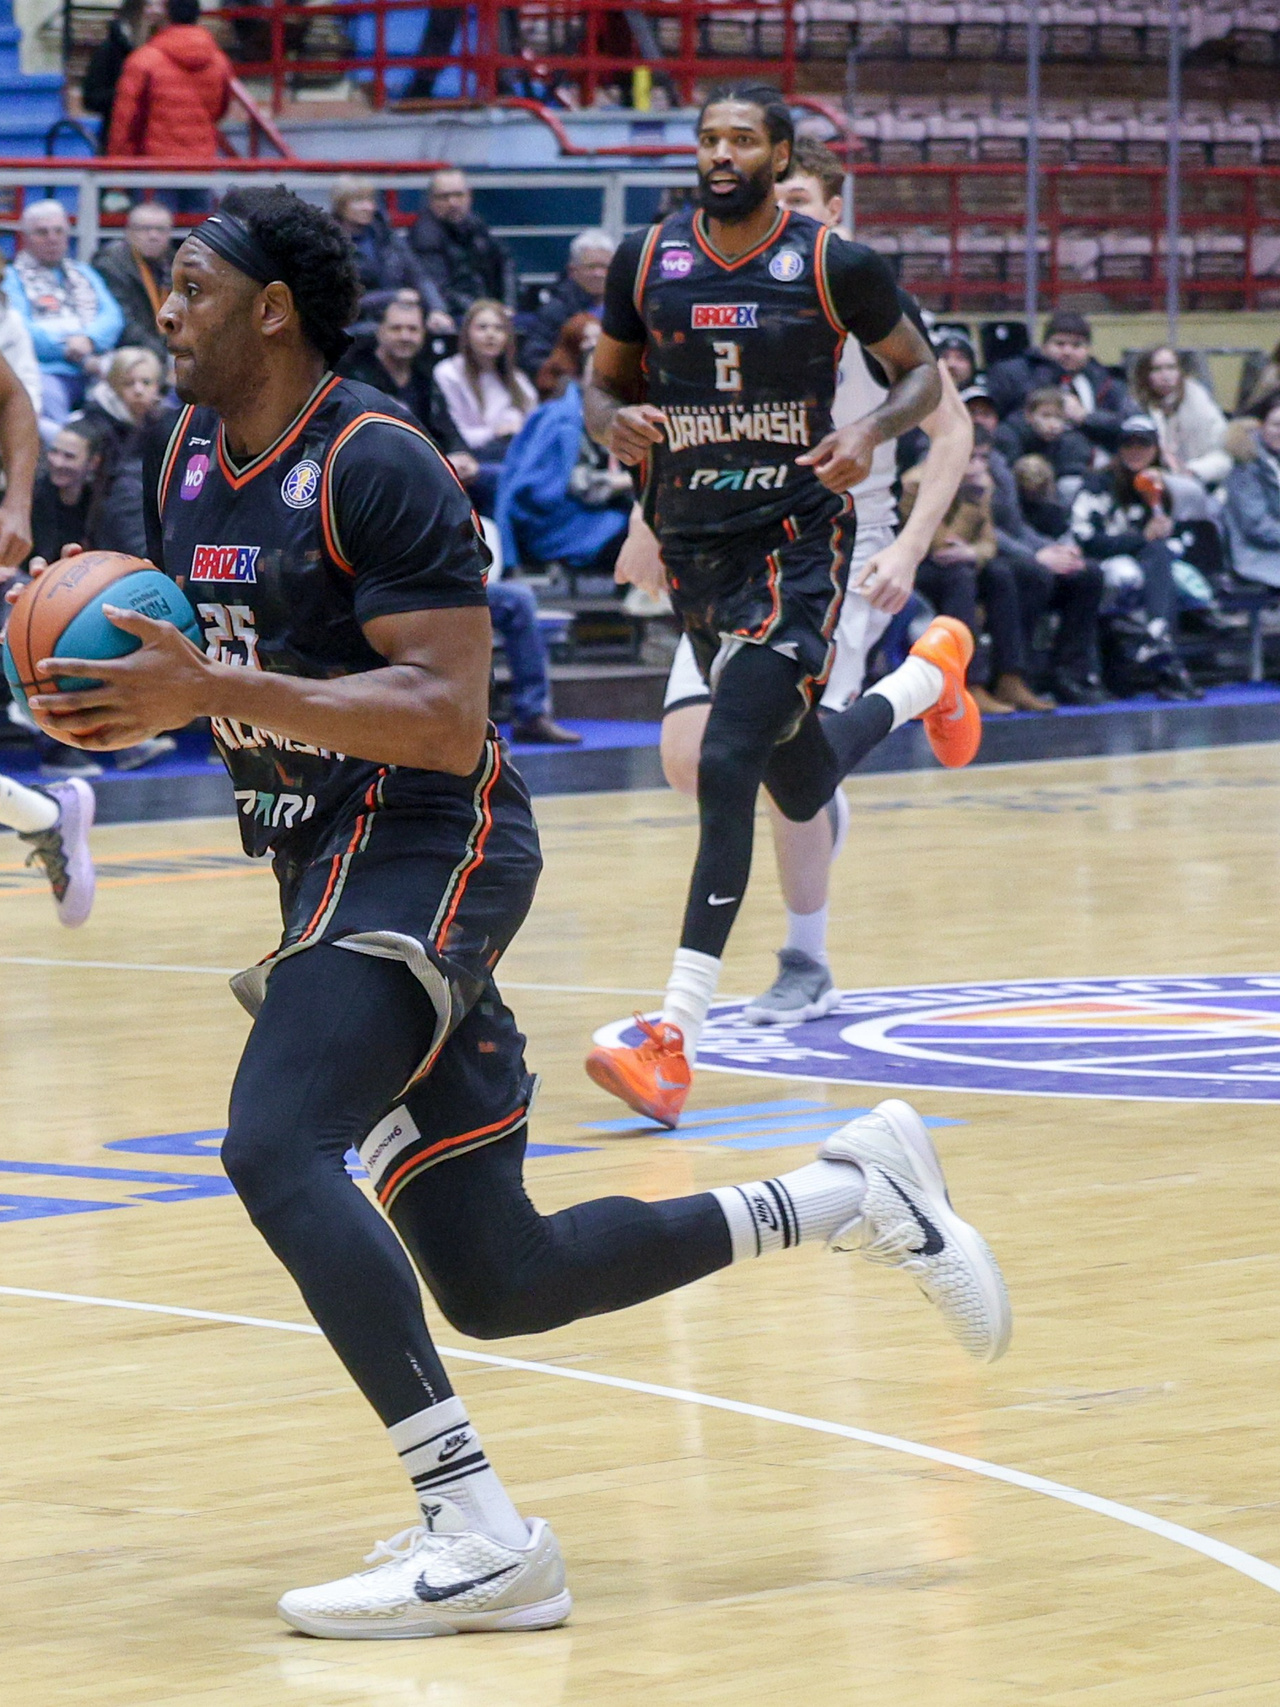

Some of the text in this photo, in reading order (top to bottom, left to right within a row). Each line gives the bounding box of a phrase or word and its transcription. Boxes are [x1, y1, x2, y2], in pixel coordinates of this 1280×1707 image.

[693, 305, 756, 327] BROZEX
[713, 341, 742, 391] 2
[664, 409, 810, 453] URALMASH
[688, 464, 788, 490] PARI
[191, 546, 258, 581] BROZEX
[197, 603, 262, 671] 25
